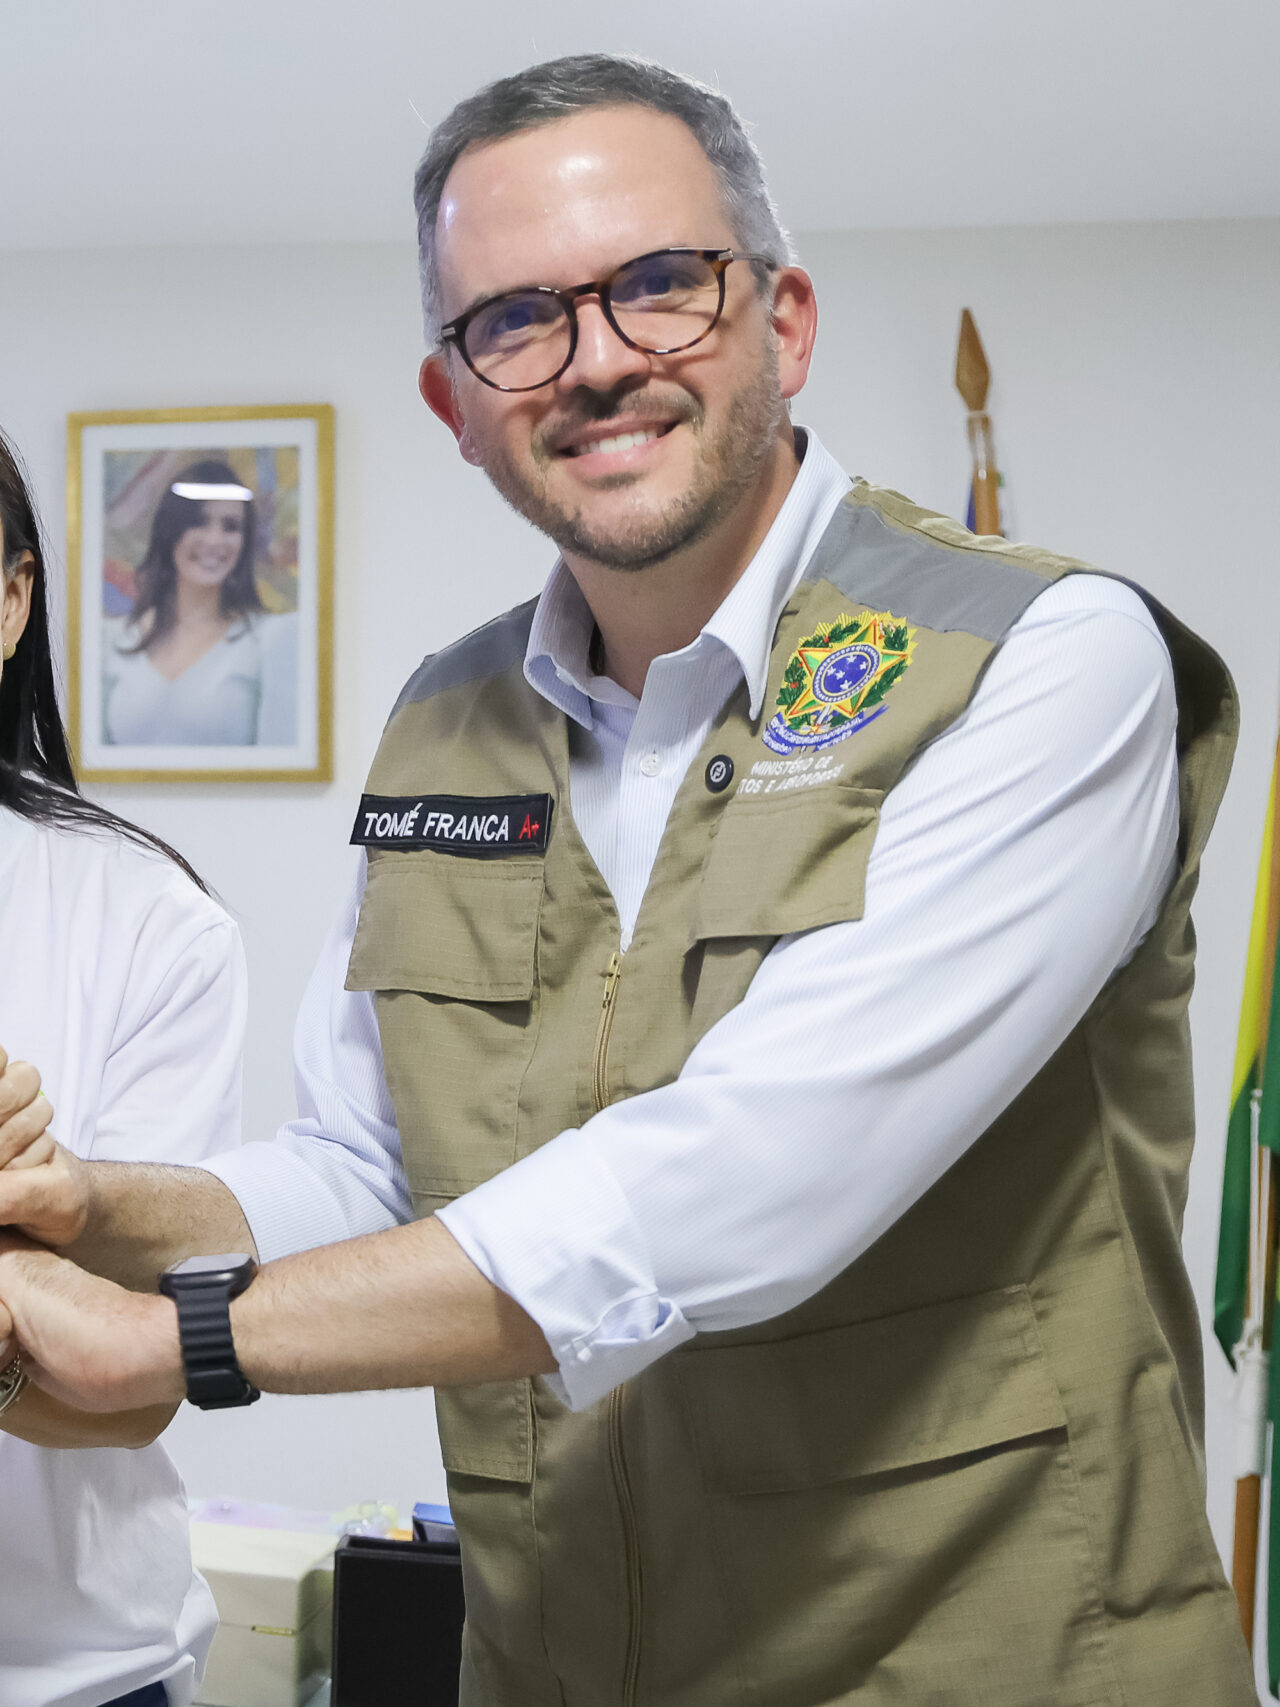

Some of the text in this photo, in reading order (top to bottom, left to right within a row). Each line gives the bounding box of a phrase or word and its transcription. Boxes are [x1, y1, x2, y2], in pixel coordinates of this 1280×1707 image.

[814, 755, 834, 770] DE
[736, 778, 764, 795] TOS
[764, 779, 776, 793] E
[364, 802, 423, 838] TOMÉ
[519, 813, 540, 840] A+
